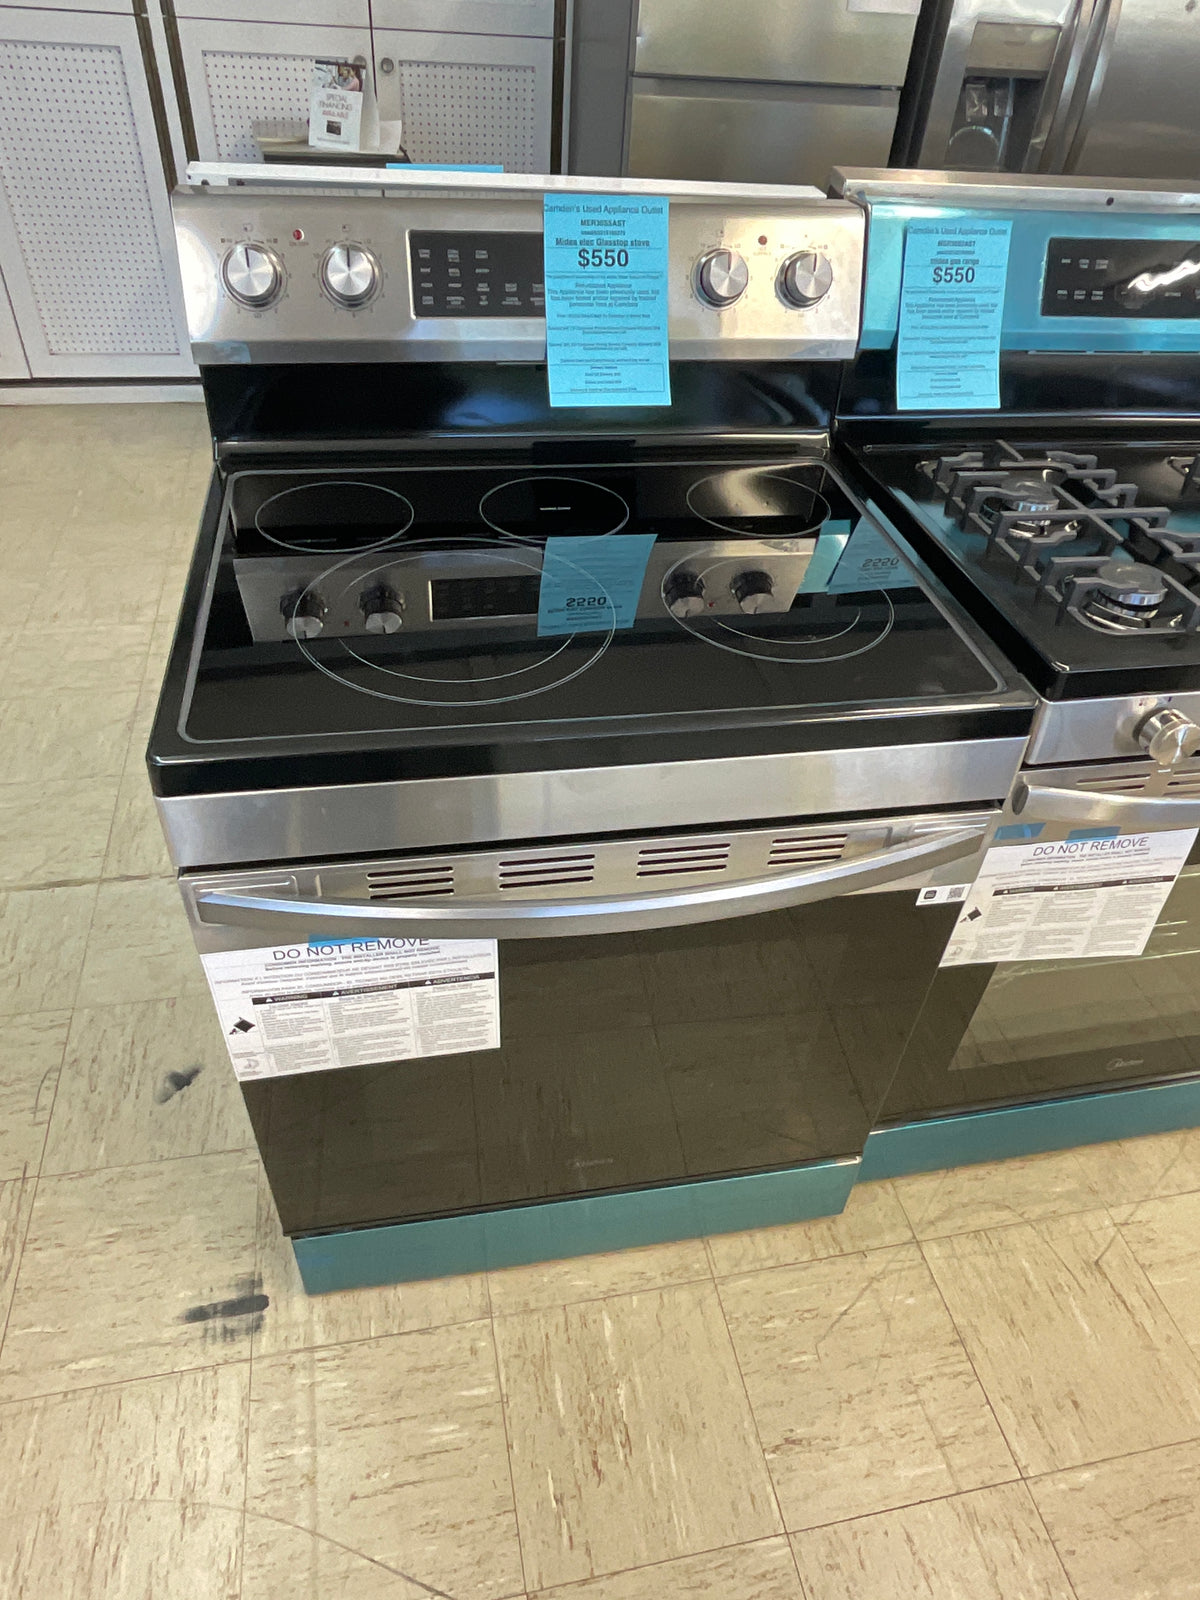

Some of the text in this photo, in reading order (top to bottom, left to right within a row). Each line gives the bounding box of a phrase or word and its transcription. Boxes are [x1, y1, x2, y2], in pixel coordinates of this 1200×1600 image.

[582, 205, 602, 213] Used
[603, 205, 639, 215] Appliance
[641, 205, 663, 214] Outlet
[596, 238, 628, 247] Glasstop
[577, 248, 629, 269] $550
[932, 266, 975, 285] $550
[1033, 837, 1149, 856] DO NOT REMOVE
[273, 938, 430, 961] DO NOT REMOVE
